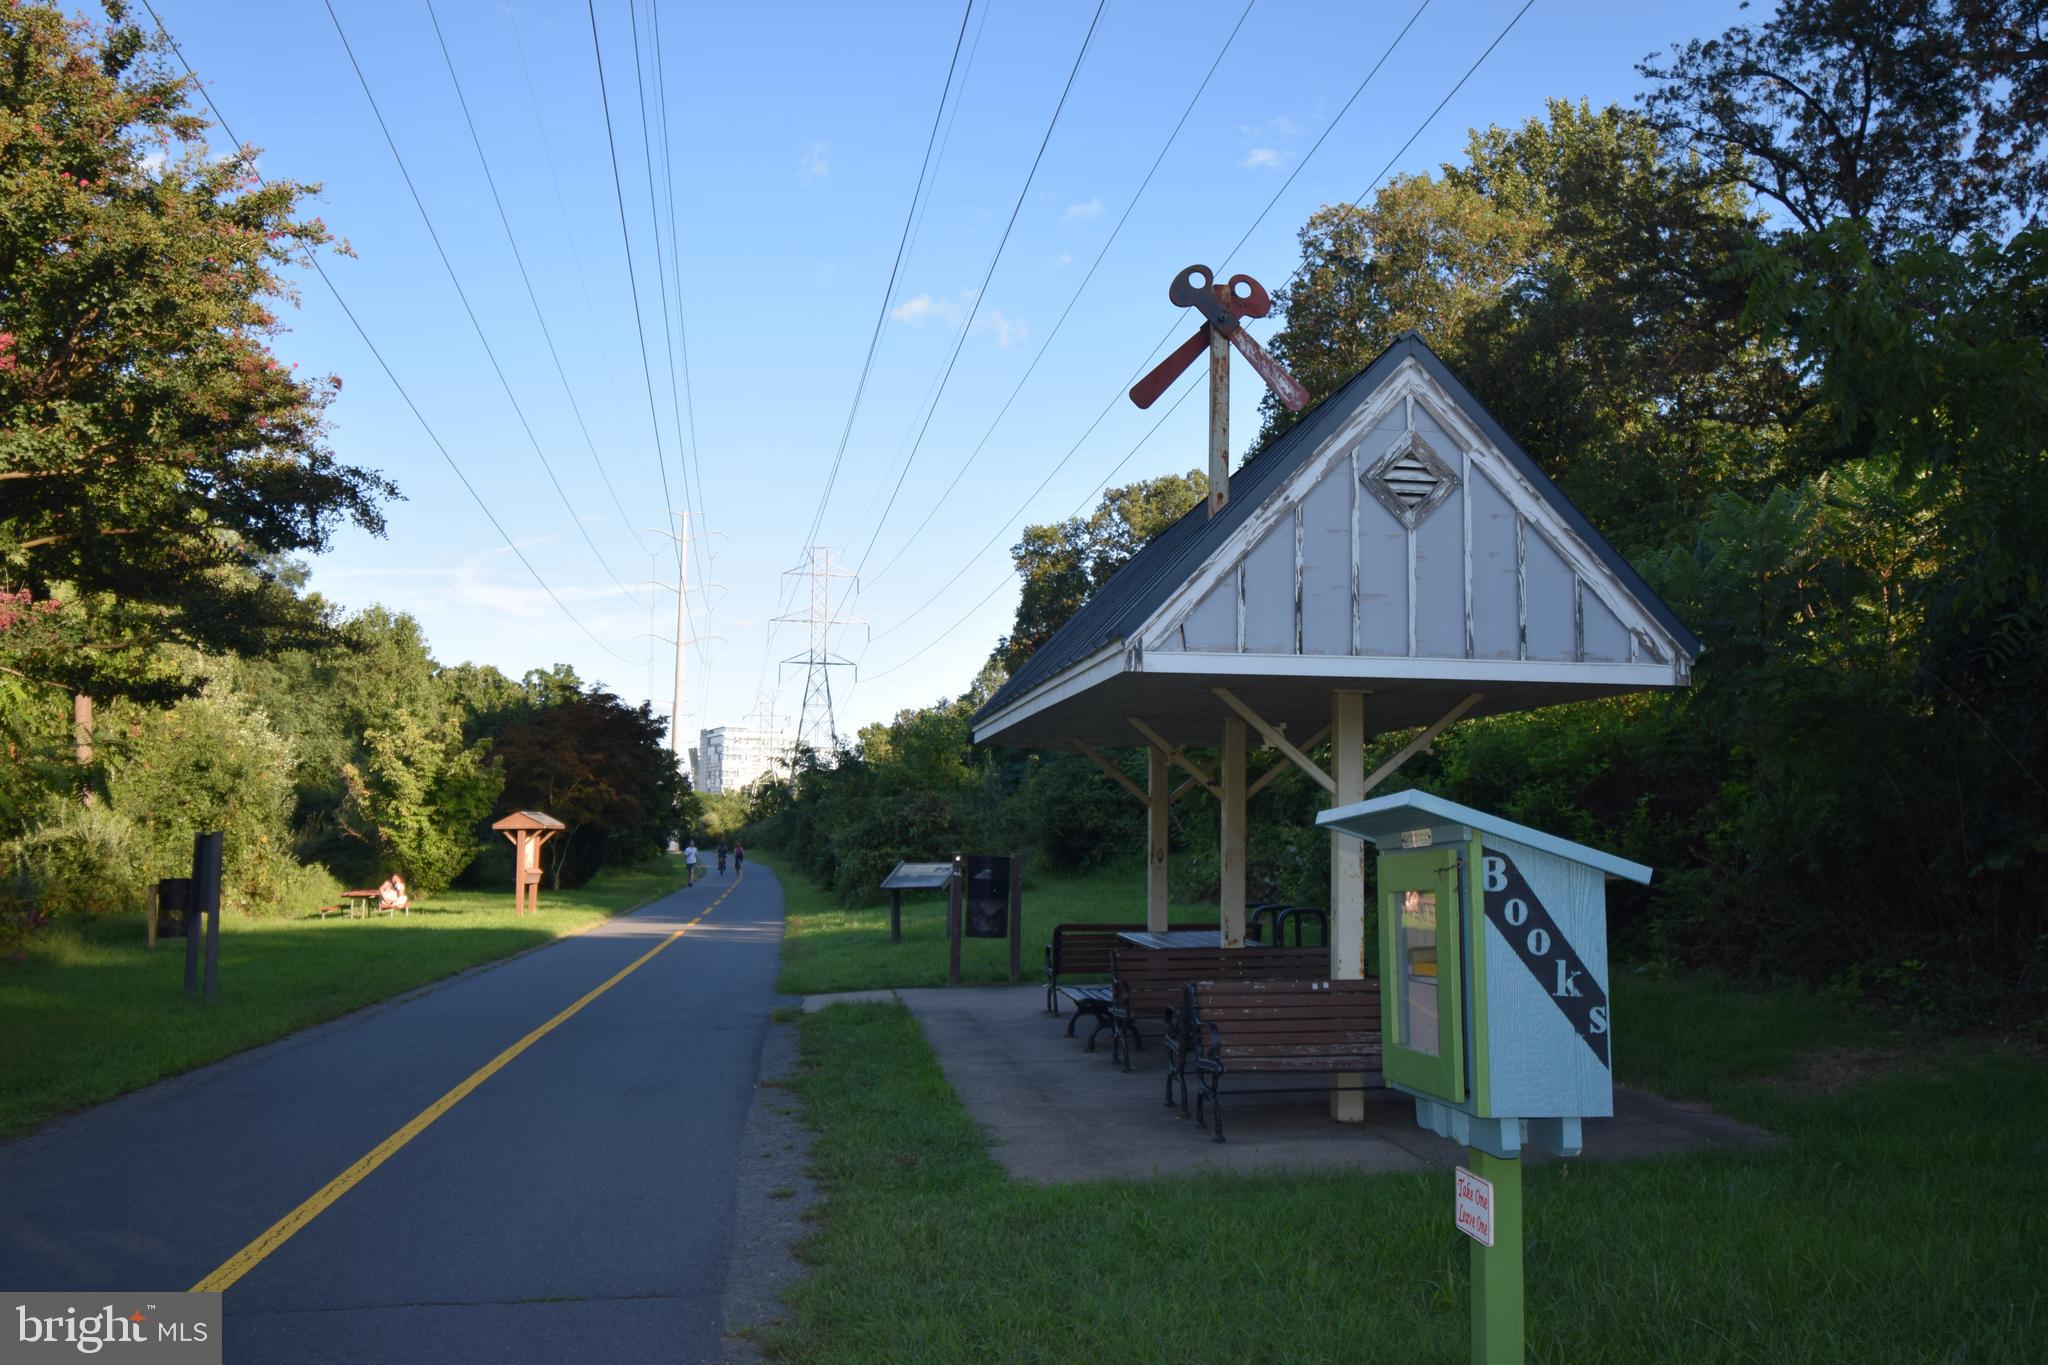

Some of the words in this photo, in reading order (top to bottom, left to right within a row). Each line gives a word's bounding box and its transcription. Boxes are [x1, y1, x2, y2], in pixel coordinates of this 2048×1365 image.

[1457, 1178, 1474, 1202] Take
[1475, 1189, 1488, 1210] One
[1458, 1204, 1476, 1229] Leave
[1476, 1215, 1488, 1236] One
